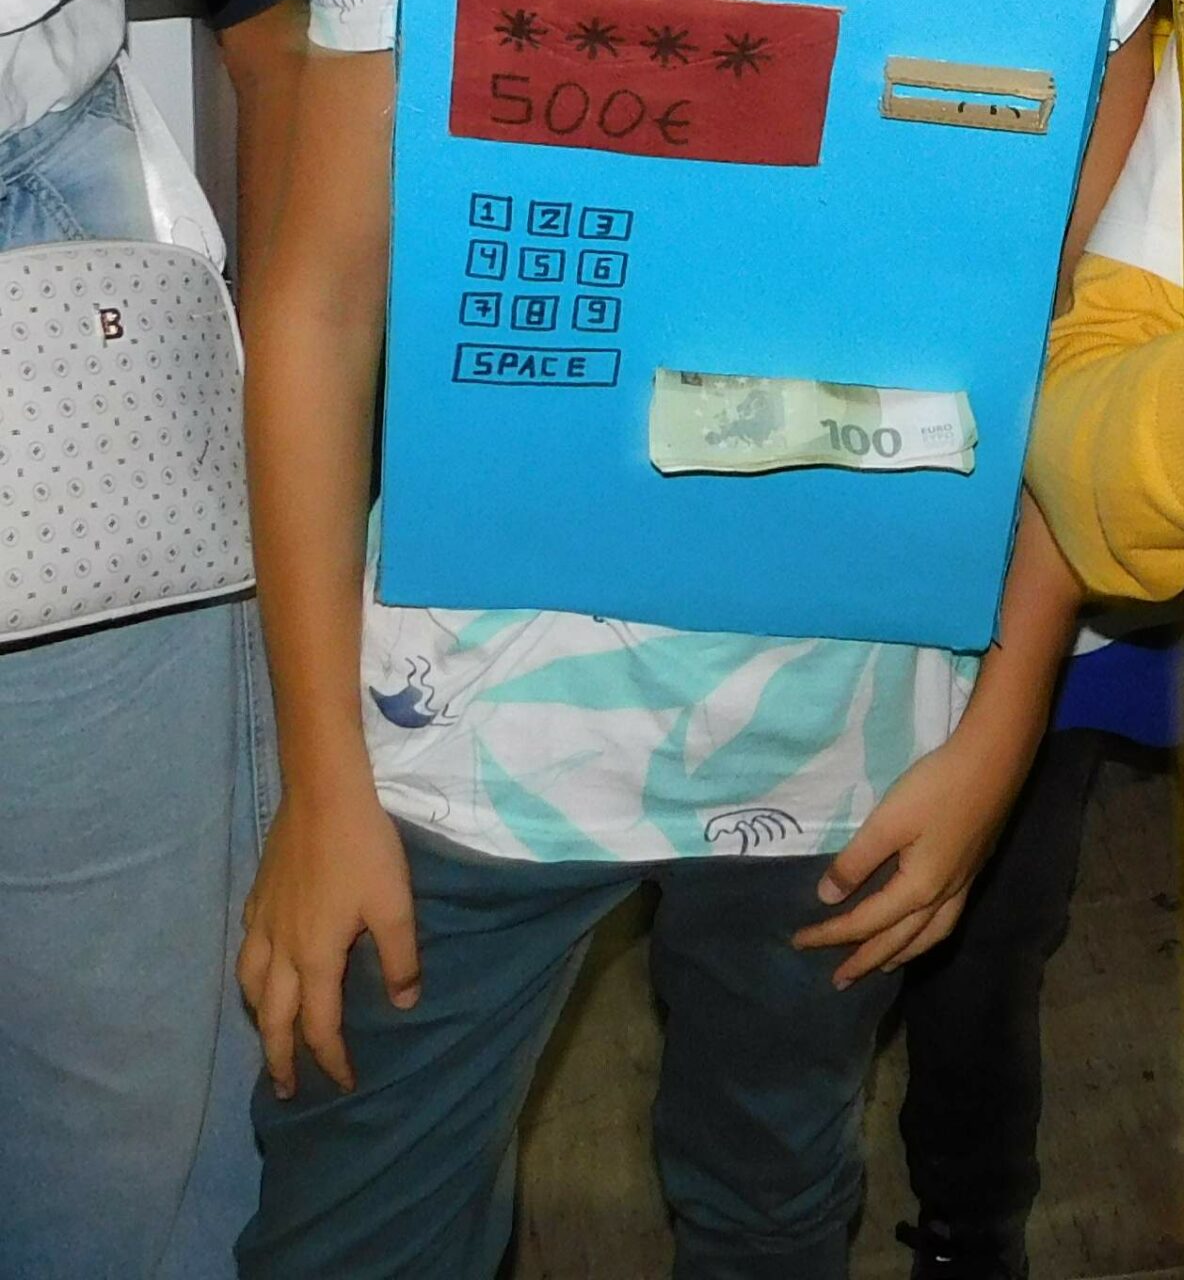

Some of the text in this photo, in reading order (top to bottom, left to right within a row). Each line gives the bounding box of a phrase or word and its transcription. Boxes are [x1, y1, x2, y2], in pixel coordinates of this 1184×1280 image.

[489, 72, 692, 146] 500€
[479, 201, 615, 237] 1 2 3
[479, 246, 613, 280] 4 5 6
[99, 307, 124, 340] B
[473, 298, 607, 325] 7 8 9
[472, 351, 587, 379] SPACE
[819, 418, 902, 458] 100
